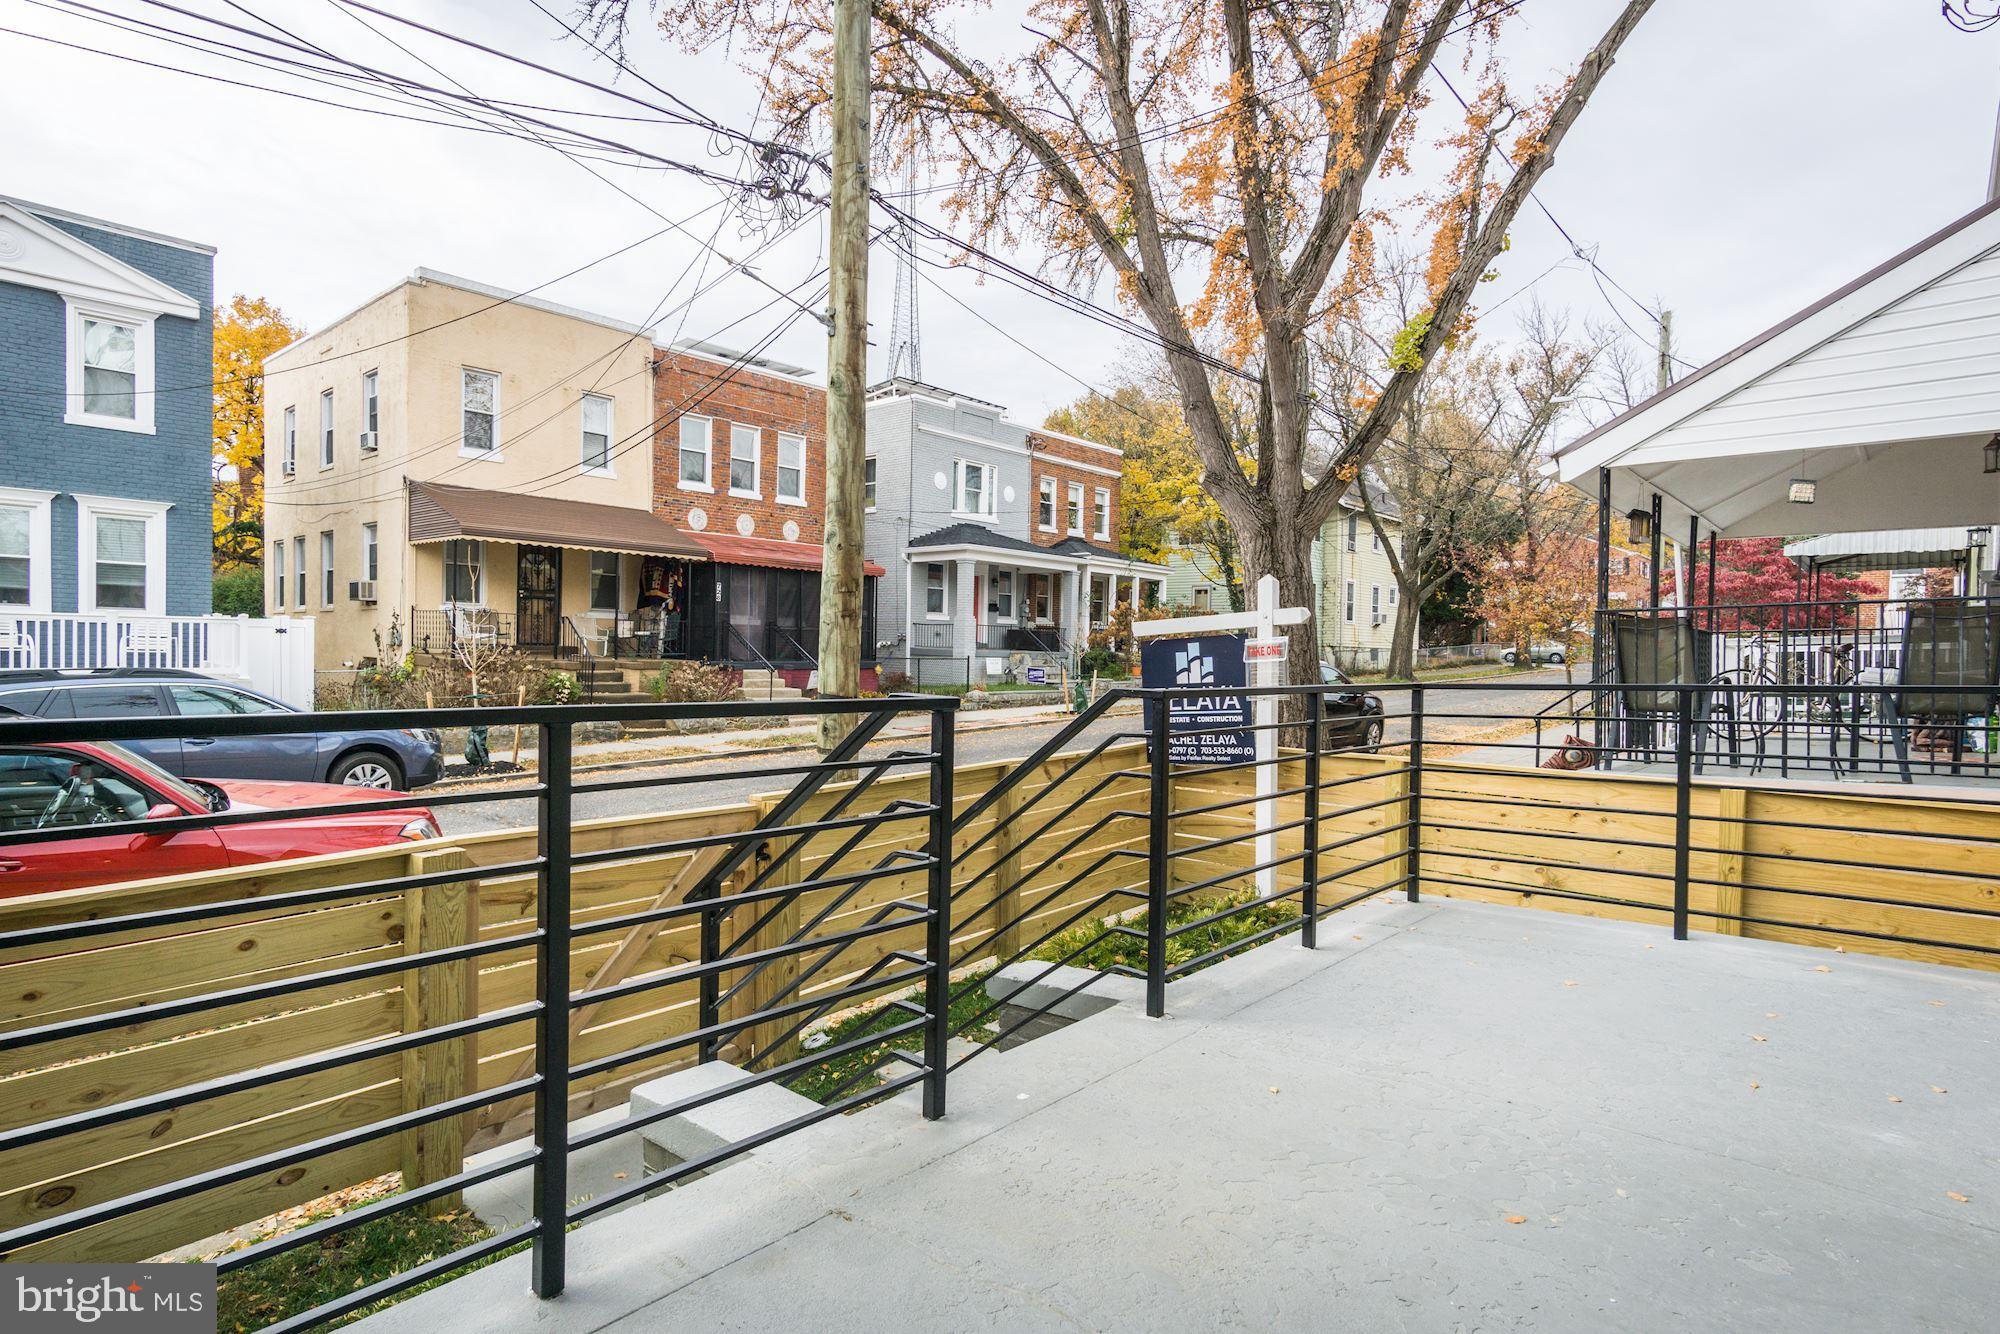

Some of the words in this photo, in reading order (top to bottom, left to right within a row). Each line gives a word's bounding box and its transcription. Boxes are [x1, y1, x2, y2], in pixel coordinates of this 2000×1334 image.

[1247, 646, 1265, 657] TAKE
[1266, 645, 1281, 656] ONE
[1169, 716, 1190, 724] ESTATE
[1196, 715, 1243, 723] CONSTRUCTION
[1168, 736, 1199, 745] ACHEL
[1200, 734, 1237, 745] ZELAYA
[1200, 747, 1243, 755] 703-533-8660
